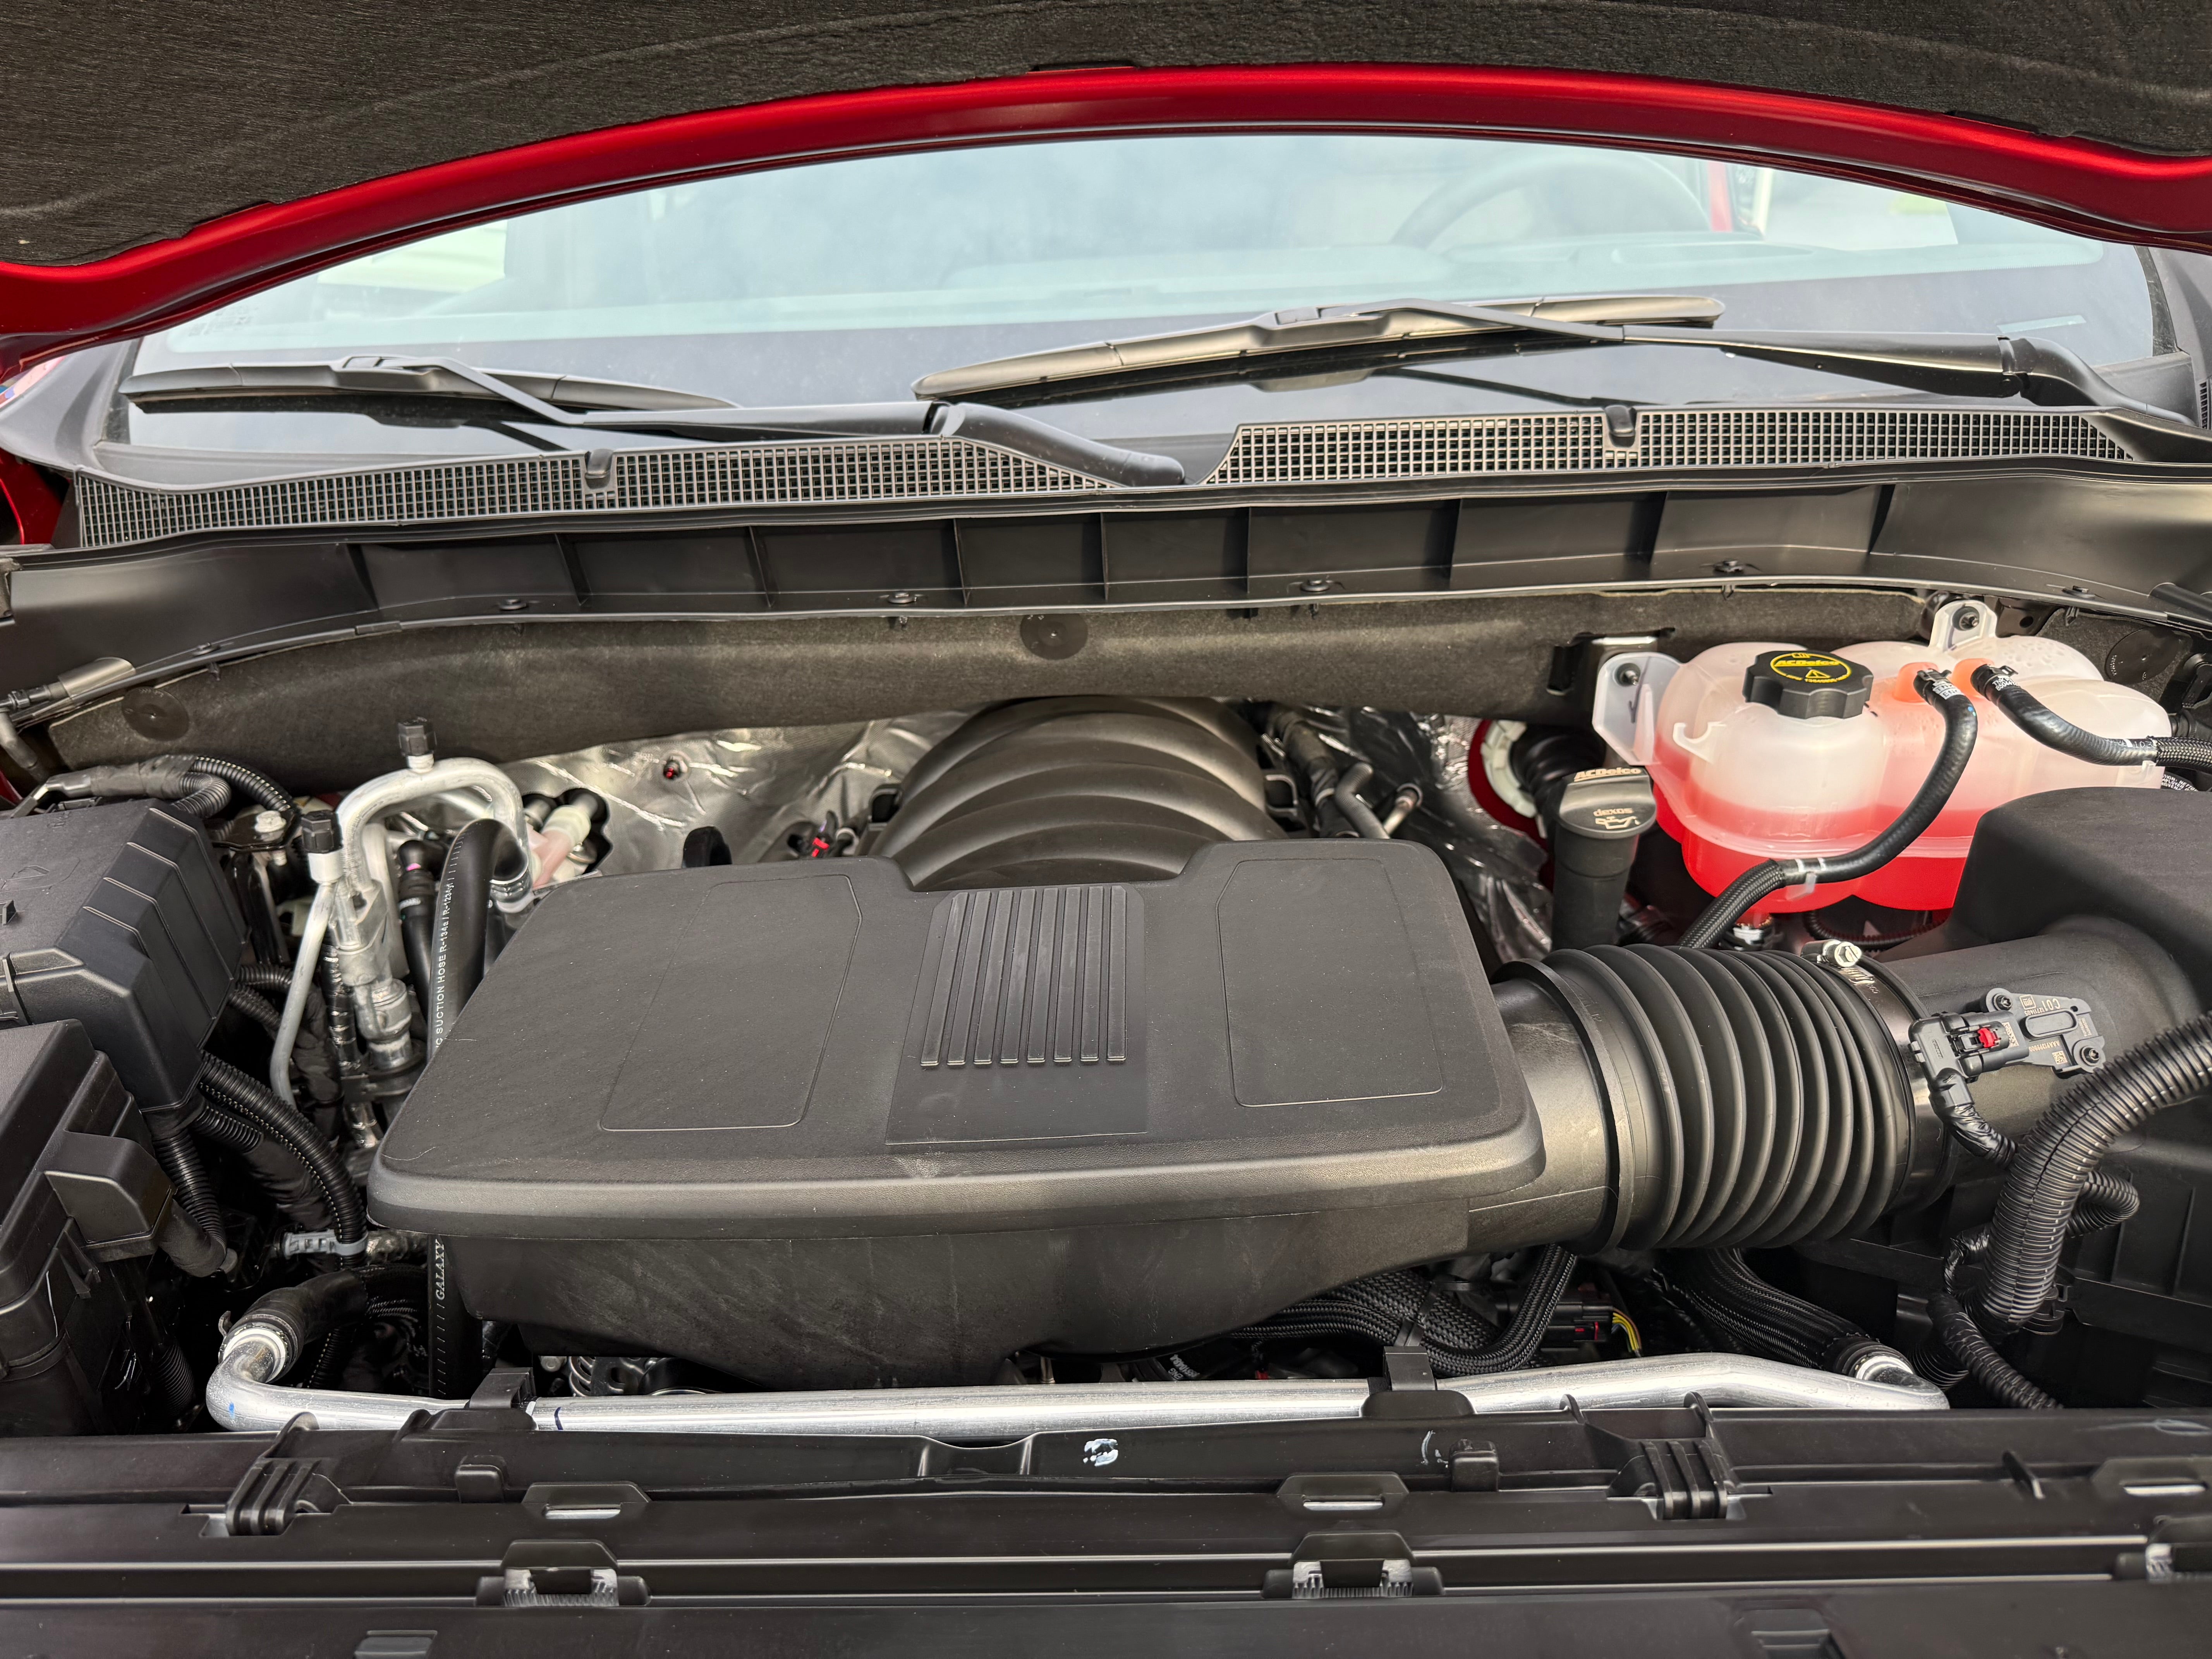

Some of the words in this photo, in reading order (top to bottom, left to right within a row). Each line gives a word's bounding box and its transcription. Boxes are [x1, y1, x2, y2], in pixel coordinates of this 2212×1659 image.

[1574, 767, 1641, 782] ACDelco
[1593, 808, 1633, 816] dexos
[440, 921, 449, 953] R-134a
[438, 954, 446, 983] HOSE
[436, 986, 445, 1034] SUCTION
[436, 1239, 445, 1300] GALAXY
